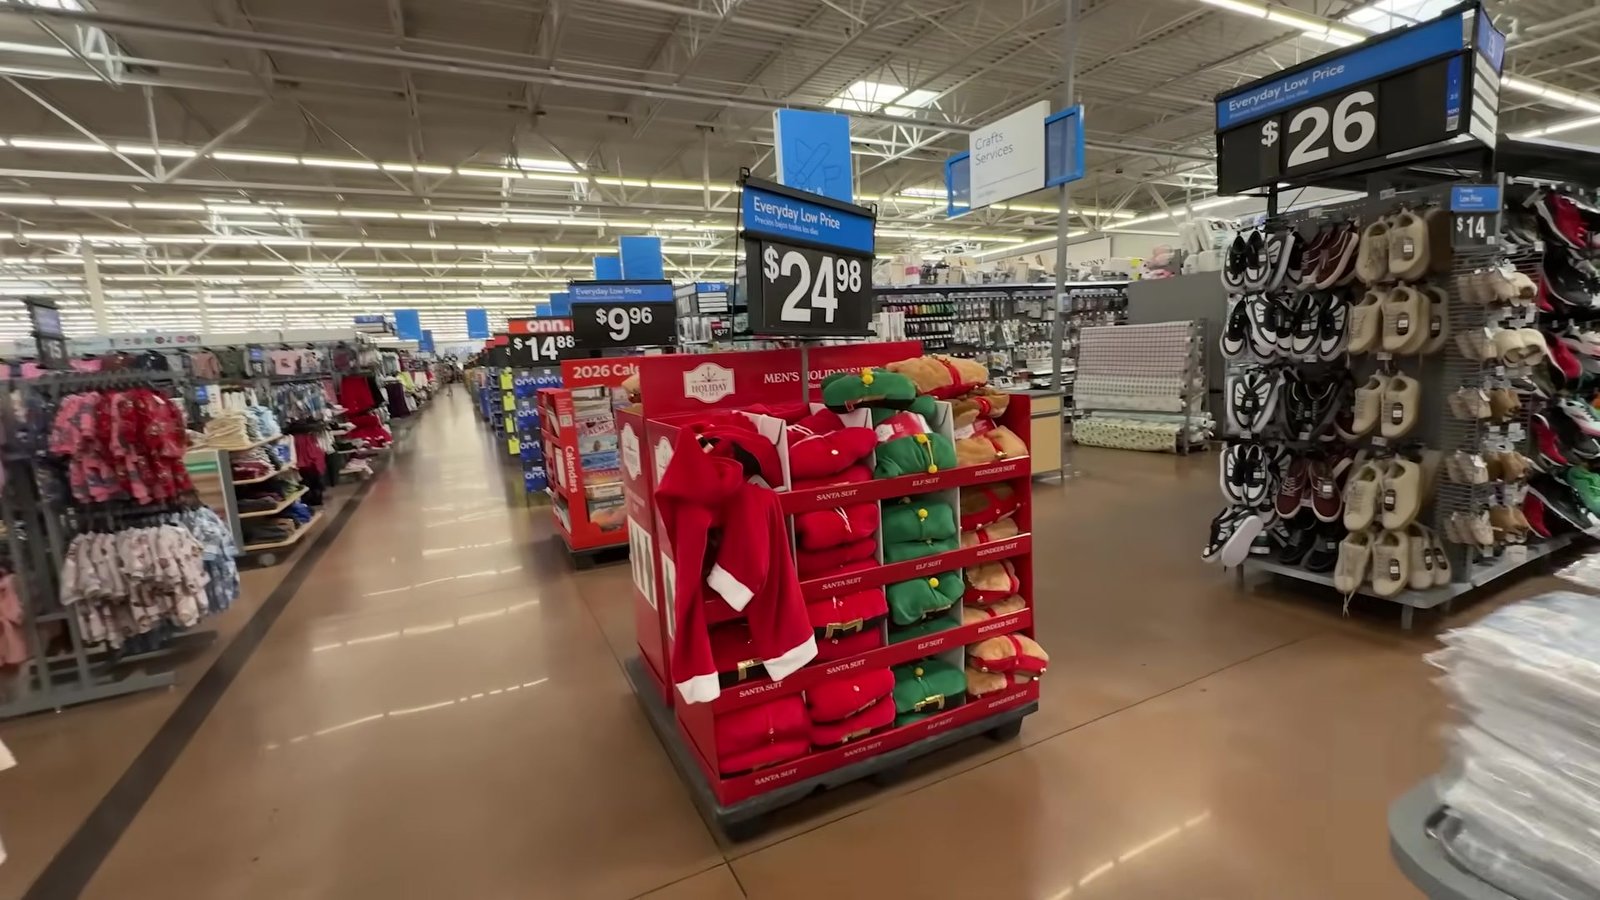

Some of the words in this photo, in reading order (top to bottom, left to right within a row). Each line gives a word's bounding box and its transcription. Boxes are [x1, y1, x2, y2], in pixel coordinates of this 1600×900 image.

[1228, 86, 1281, 112] Everyday
[1284, 78, 1308, 93] Low
[1312, 64, 1345, 83] Price
[974, 131, 1004, 151] Crafts
[974, 143, 1014, 166] Services
[753, 196, 799, 223] Everyday
[801, 207, 818, 223] Low
[820, 212, 840, 230] Price
[1080, 258, 1106, 268] SONY
[575, 288, 608, 297] Everyday
[609, 288, 624, 296] Low
[526, 320, 571, 333] onn.
[572, 365, 611, 379] 2026
[764, 372, 800, 384] MEN'S
[691, 383, 728, 393] HOLIDAY
[565, 445, 578, 493] Calendars
[974, 467, 1003, 477] REINDEER
[1002, 464, 1017, 473] SUIT
[924, 477, 940, 485] SUIT
[816, 493, 840, 501] SANTA
[840, 489, 858, 498] SUIT
[976, 546, 1004, 557] REINDEER
[1004, 542, 1018, 551] SUIT
[915, 563, 928, 571] ELF
[927, 560, 942, 568] SUIT
[822, 580, 845, 590] SANTA
[844, 577, 862, 586] SUIT
[977, 621, 1006, 634] REINDEER
[1005, 618, 1019, 627] SUIT
[917, 641, 929, 650] ELF
[928, 638, 944, 647] SUIT
[826, 663, 850, 675] SANTA
[849, 659, 866, 668] SUIT
[739, 686, 765, 698] SANTA
[765, 680, 783, 691] SUIT
[844, 745, 868, 757] SANTA
[866, 741, 882, 750] SUIT
[754, 773, 780, 786] SANTA
[780, 768, 798, 778] SUIT
